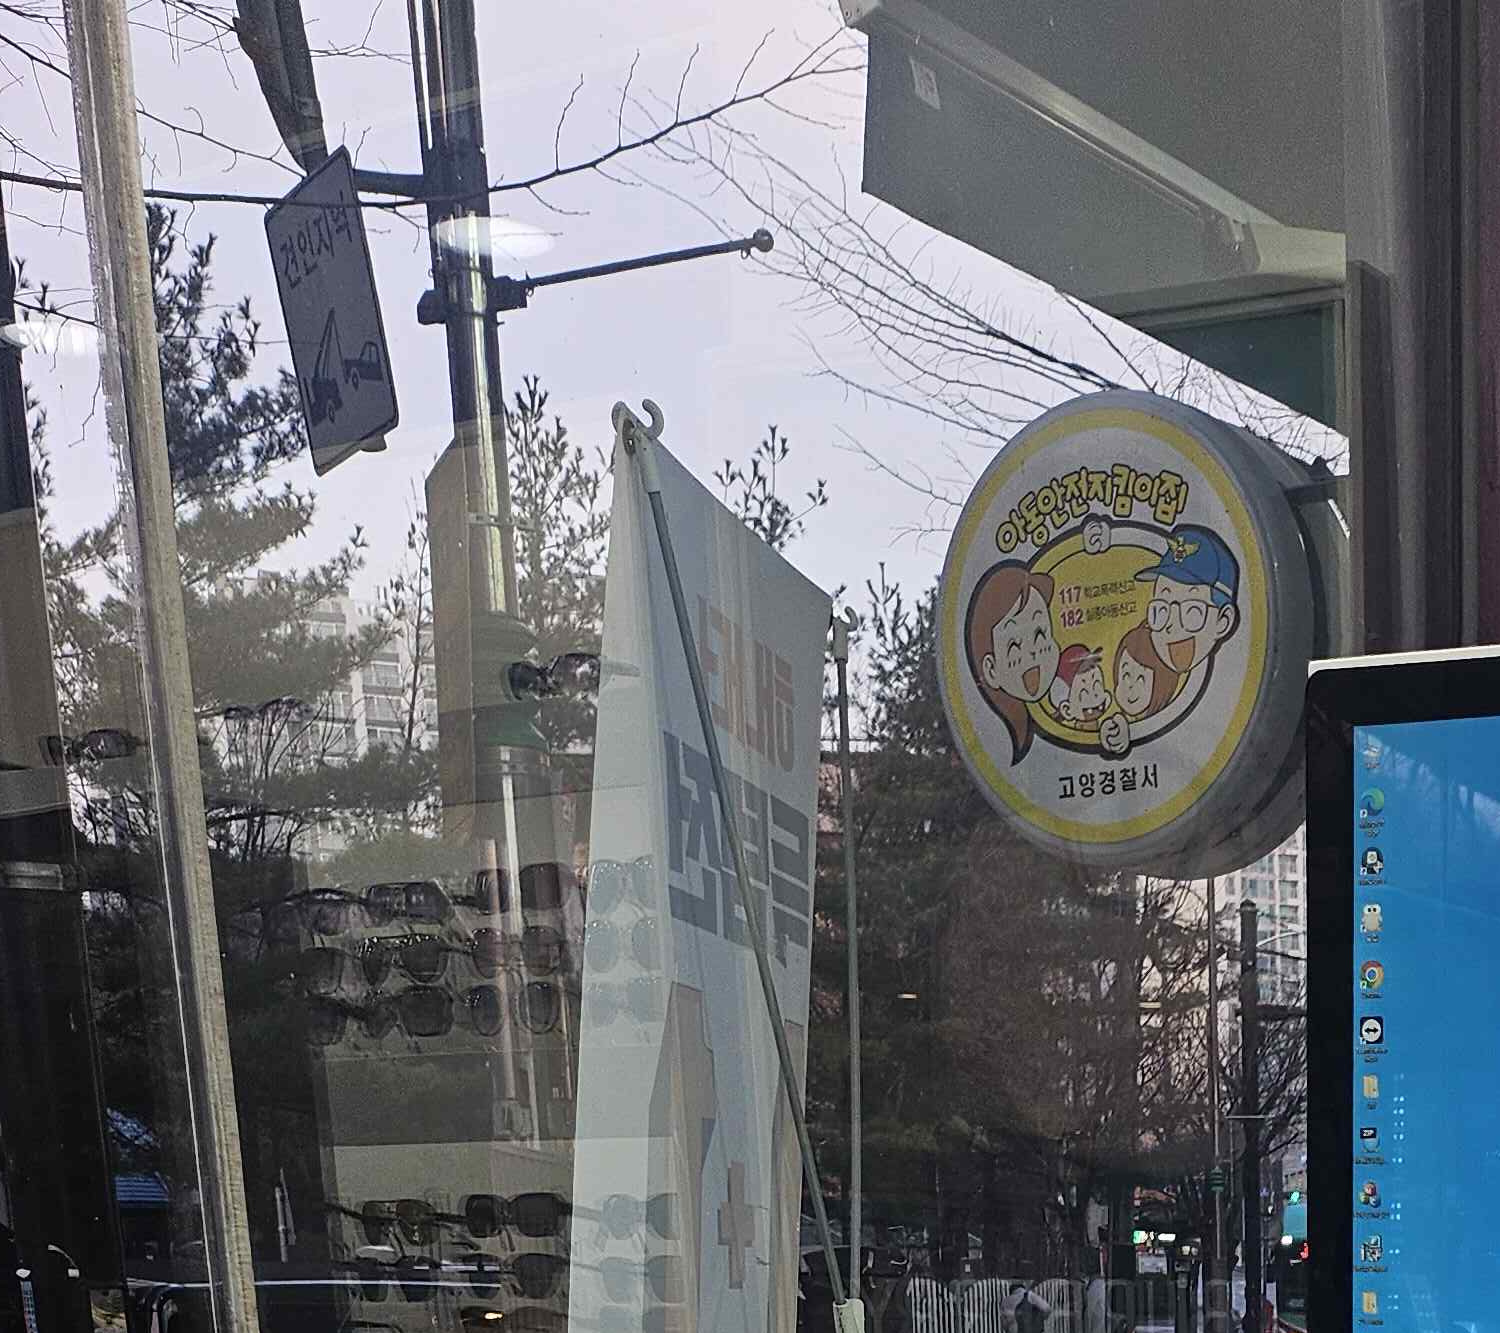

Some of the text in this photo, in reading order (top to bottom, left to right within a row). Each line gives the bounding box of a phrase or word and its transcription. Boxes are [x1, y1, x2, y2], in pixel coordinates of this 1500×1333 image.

[280, 190, 352, 289] 견인지역
[996, 463, 1189, 553] 아동안전지킴이집
[1060, 586, 1081, 604] 117
[1060, 608, 1084, 628] 182
[1058, 764, 1159, 799] 고양경찰서
